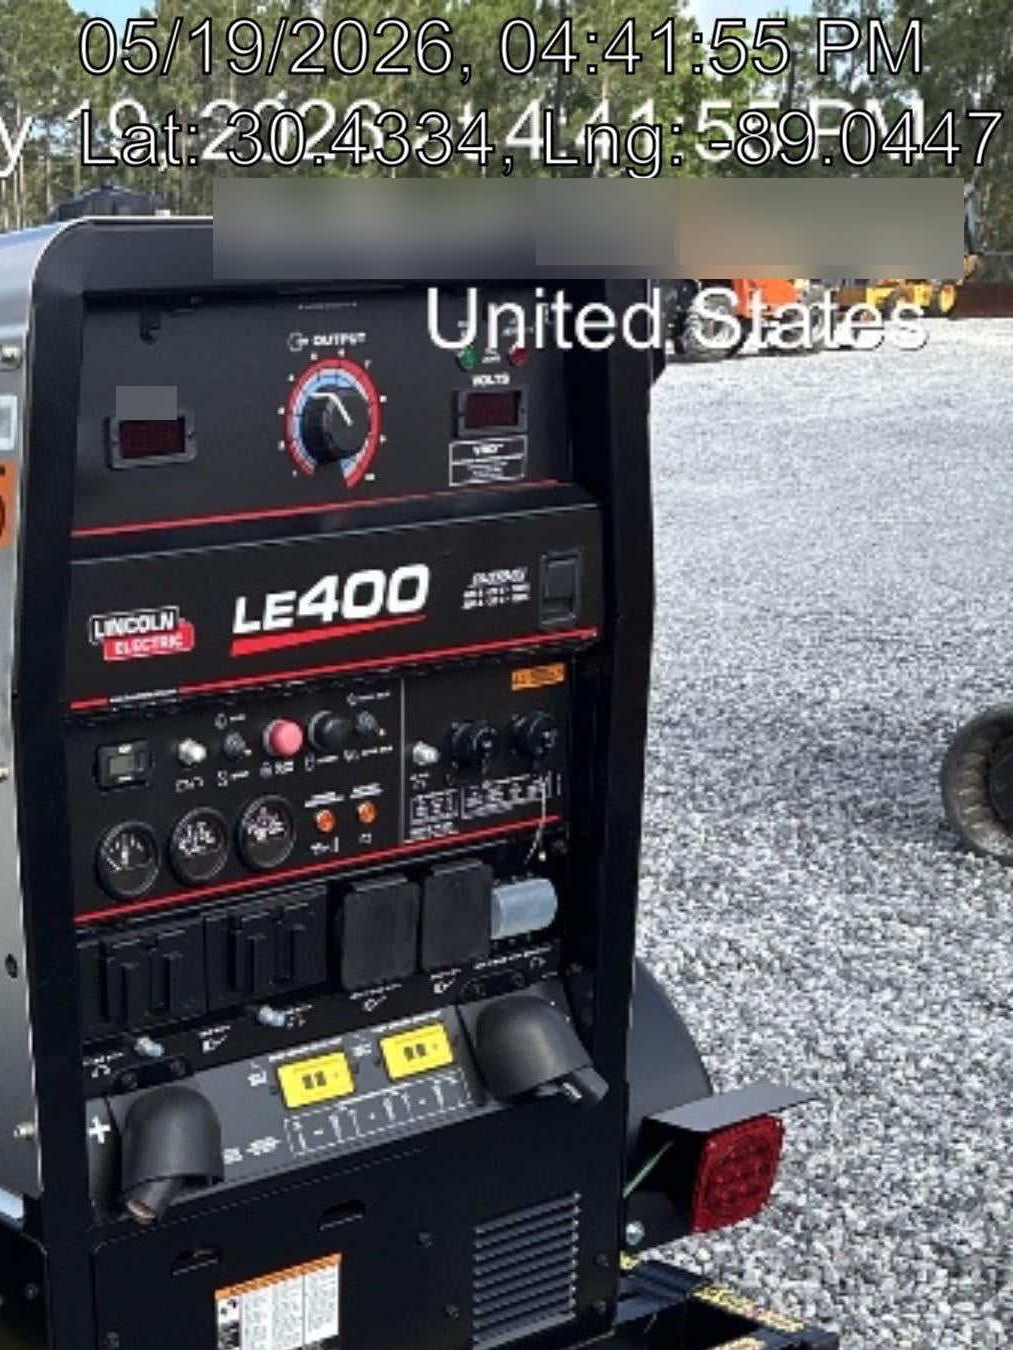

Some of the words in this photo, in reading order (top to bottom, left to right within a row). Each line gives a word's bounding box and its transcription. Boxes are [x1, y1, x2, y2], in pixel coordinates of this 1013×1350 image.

[312, 331, 367, 347] OUTPUT
[232, 563, 430, 635] LE400
[93, 610, 174, 638] LINCOLN
[114, 632, 184, 655] ELECTRIC
